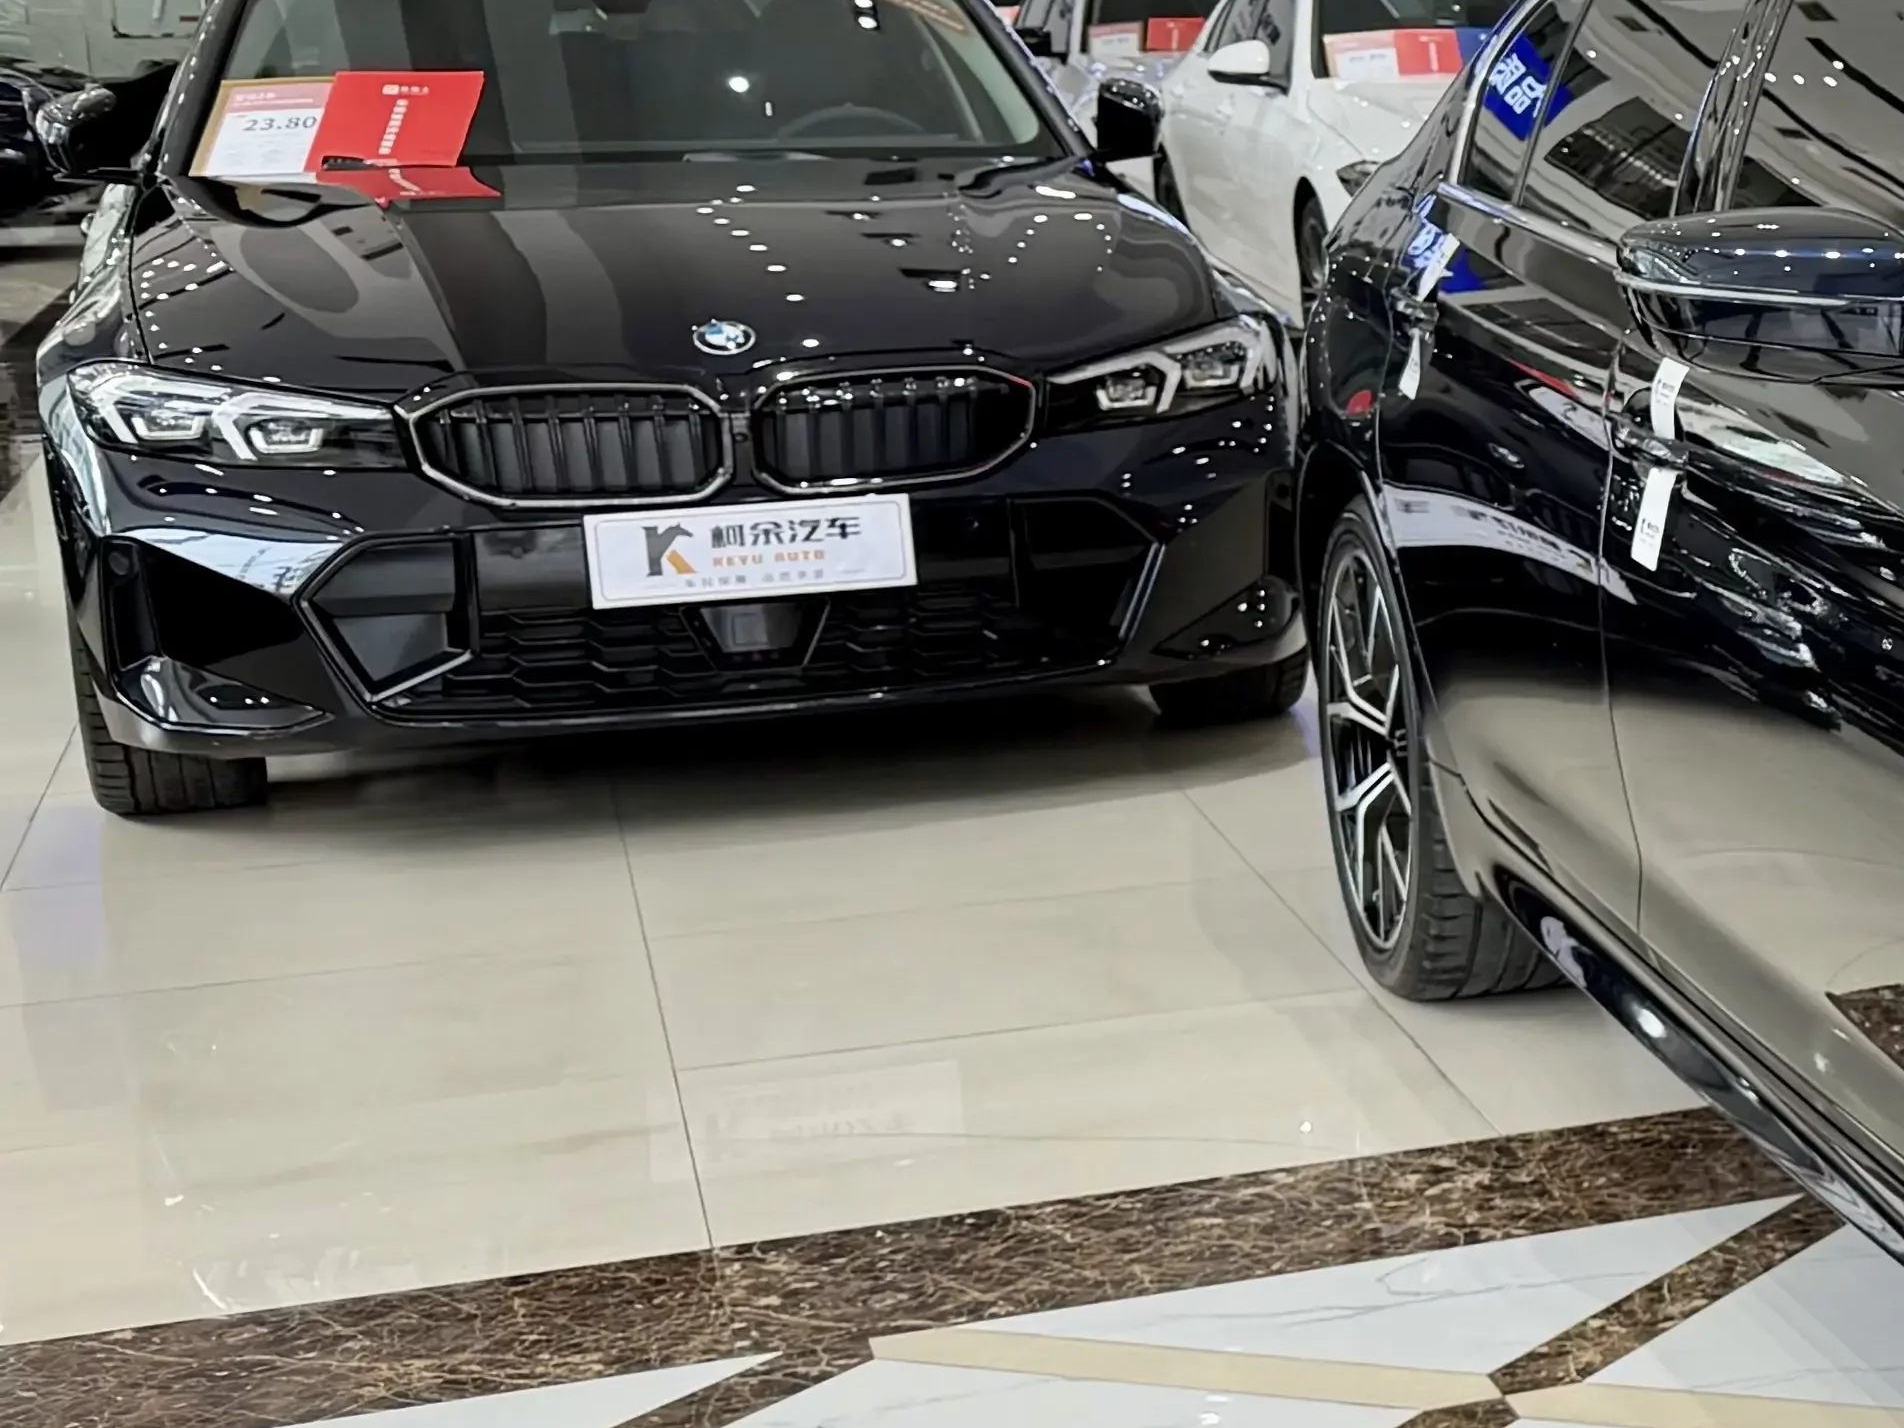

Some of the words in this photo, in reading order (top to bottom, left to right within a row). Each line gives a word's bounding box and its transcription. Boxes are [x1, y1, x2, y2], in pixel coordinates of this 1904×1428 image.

[242, 115, 318, 132] 23.80
[709, 516, 862, 550] 柯余汽车
[713, 553, 763, 568] KEYU
[774, 549, 827, 564] AUTO
